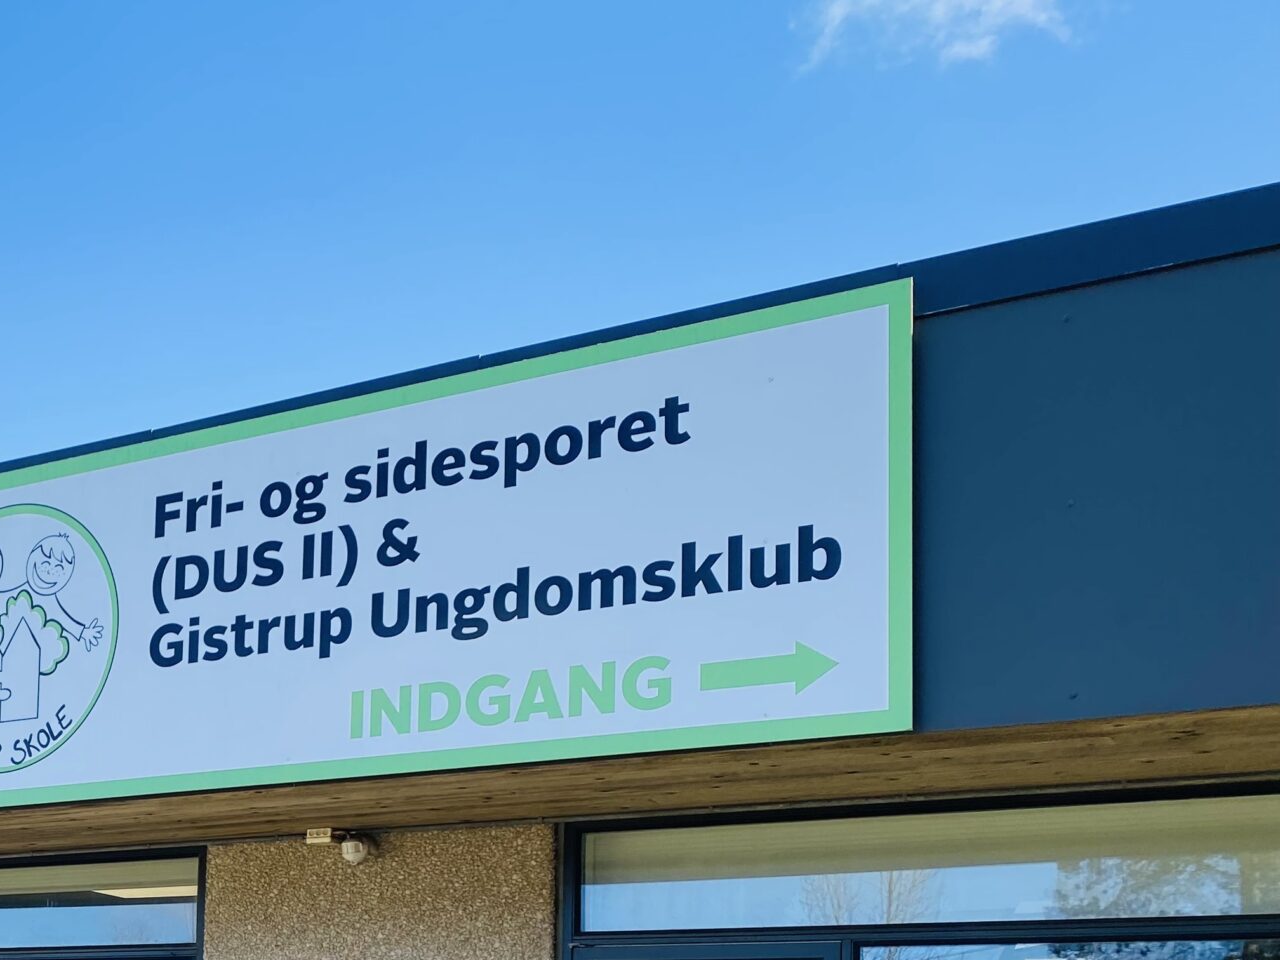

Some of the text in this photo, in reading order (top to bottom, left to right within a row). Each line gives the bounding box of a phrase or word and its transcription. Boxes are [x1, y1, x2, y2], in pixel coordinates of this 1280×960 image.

[154, 395, 691, 538] Fri- og sidesporet
[149, 524, 842, 668] Gistrup Ungdomsklub
[152, 518, 421, 615] (DUS II) &
[10, 704, 74, 765] SKOLE
[350, 656, 672, 739] INDGANG
